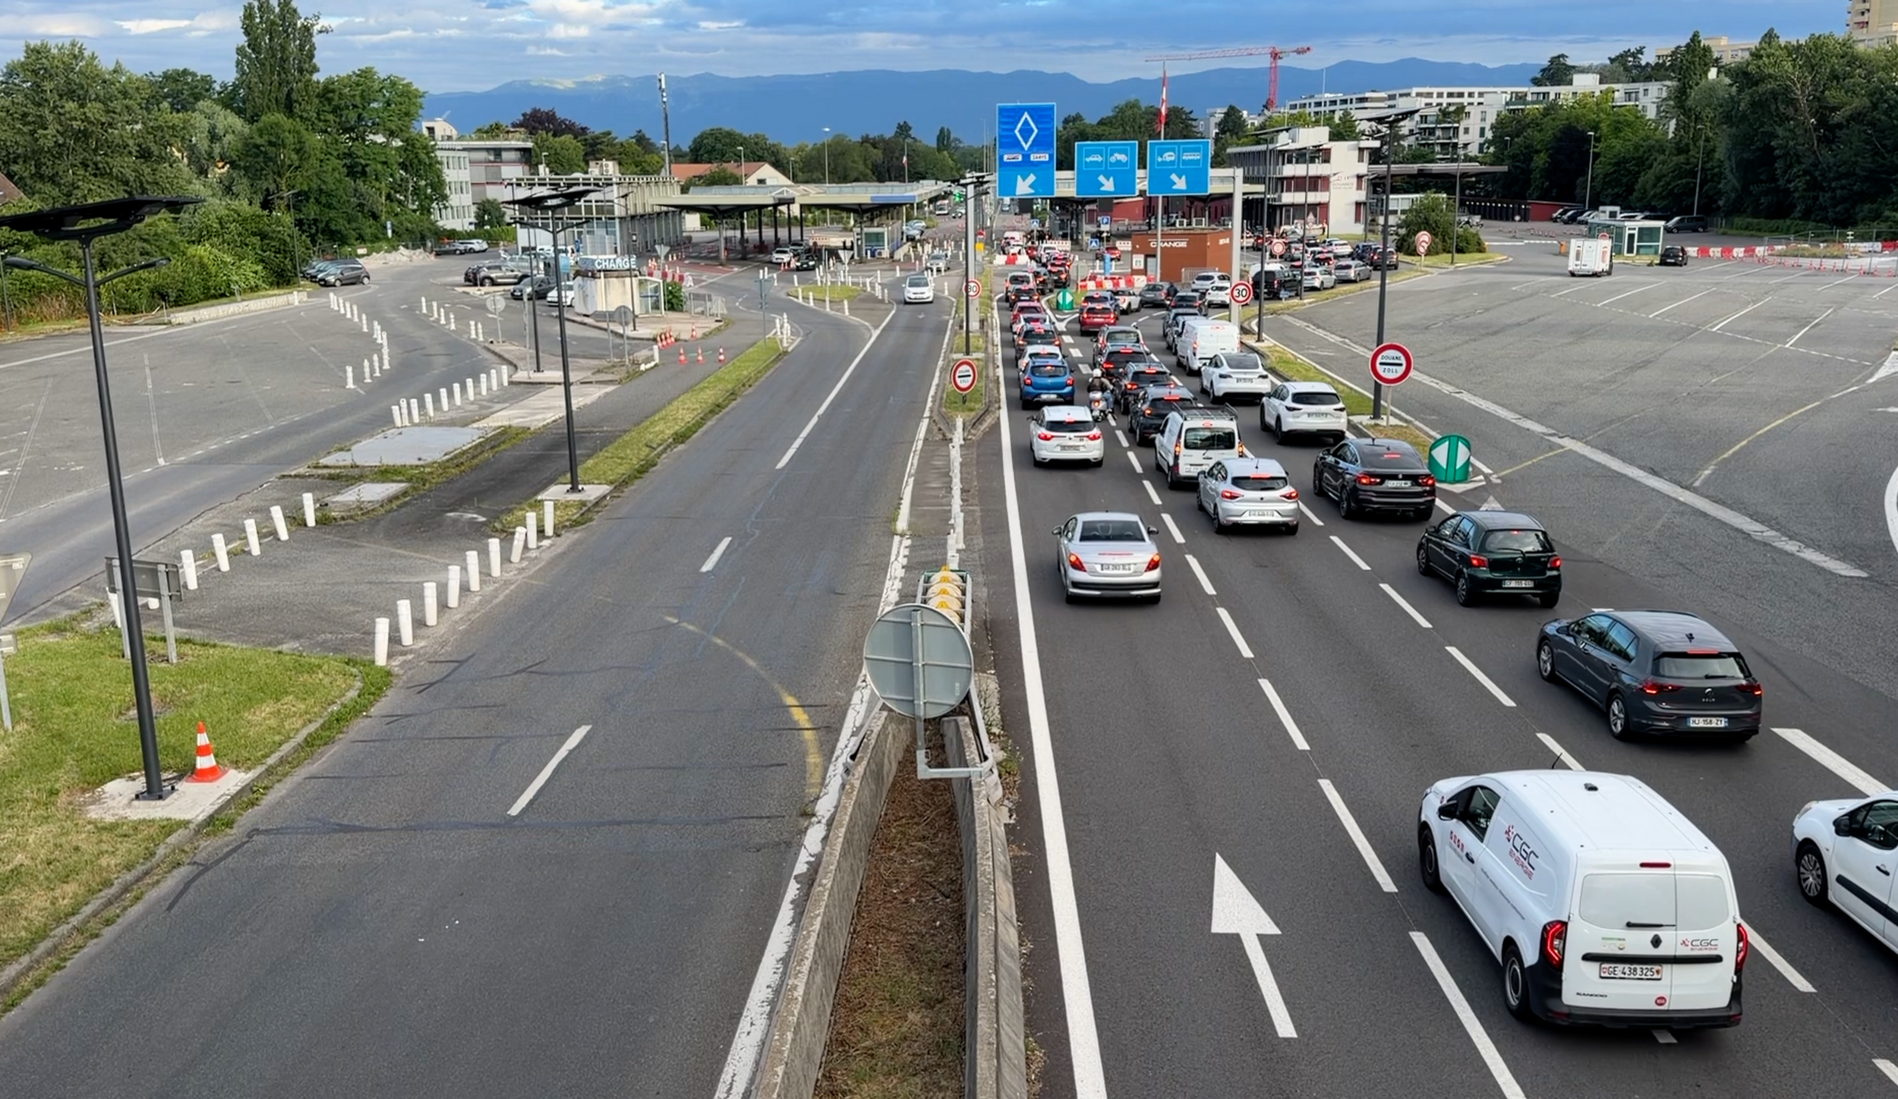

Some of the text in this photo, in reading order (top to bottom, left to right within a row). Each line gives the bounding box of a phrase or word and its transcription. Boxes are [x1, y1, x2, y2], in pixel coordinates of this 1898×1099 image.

[595, 259, 637, 269] CHANGE
[1235, 288, 1248, 298] 30
[1512, 833, 1539, 871] CGC
[1690, 938, 1719, 947] CGC
